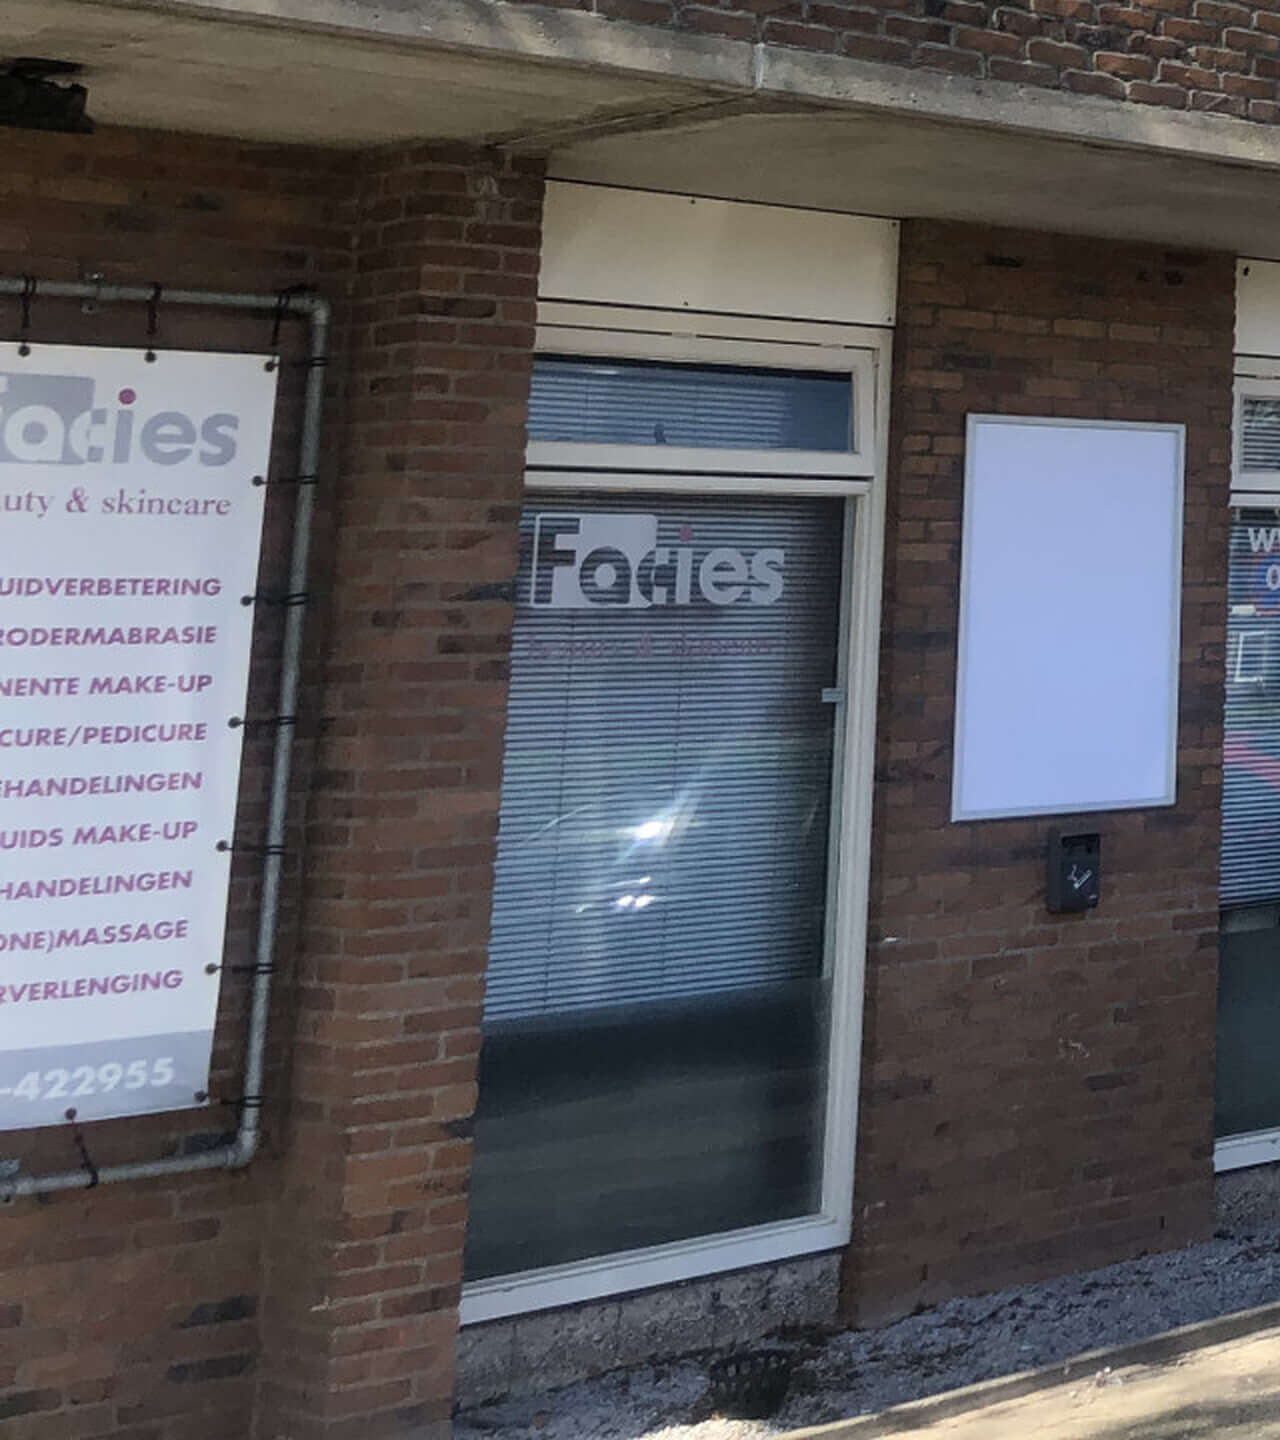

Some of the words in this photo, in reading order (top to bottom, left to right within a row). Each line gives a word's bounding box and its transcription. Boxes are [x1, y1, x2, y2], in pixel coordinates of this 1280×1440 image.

[0, 372, 240, 467] acies
[65, 486, 89, 514] &
[101, 488, 232, 517] skincare
[88, 674, 213, 695] MAKE-UP
[0, 722, 208, 748] CURE/PEDICURE
[0, 771, 204, 799] HANDELINGEN
[1, 827, 63, 850] UIDS
[72, 820, 199, 846] MAKE-UP
